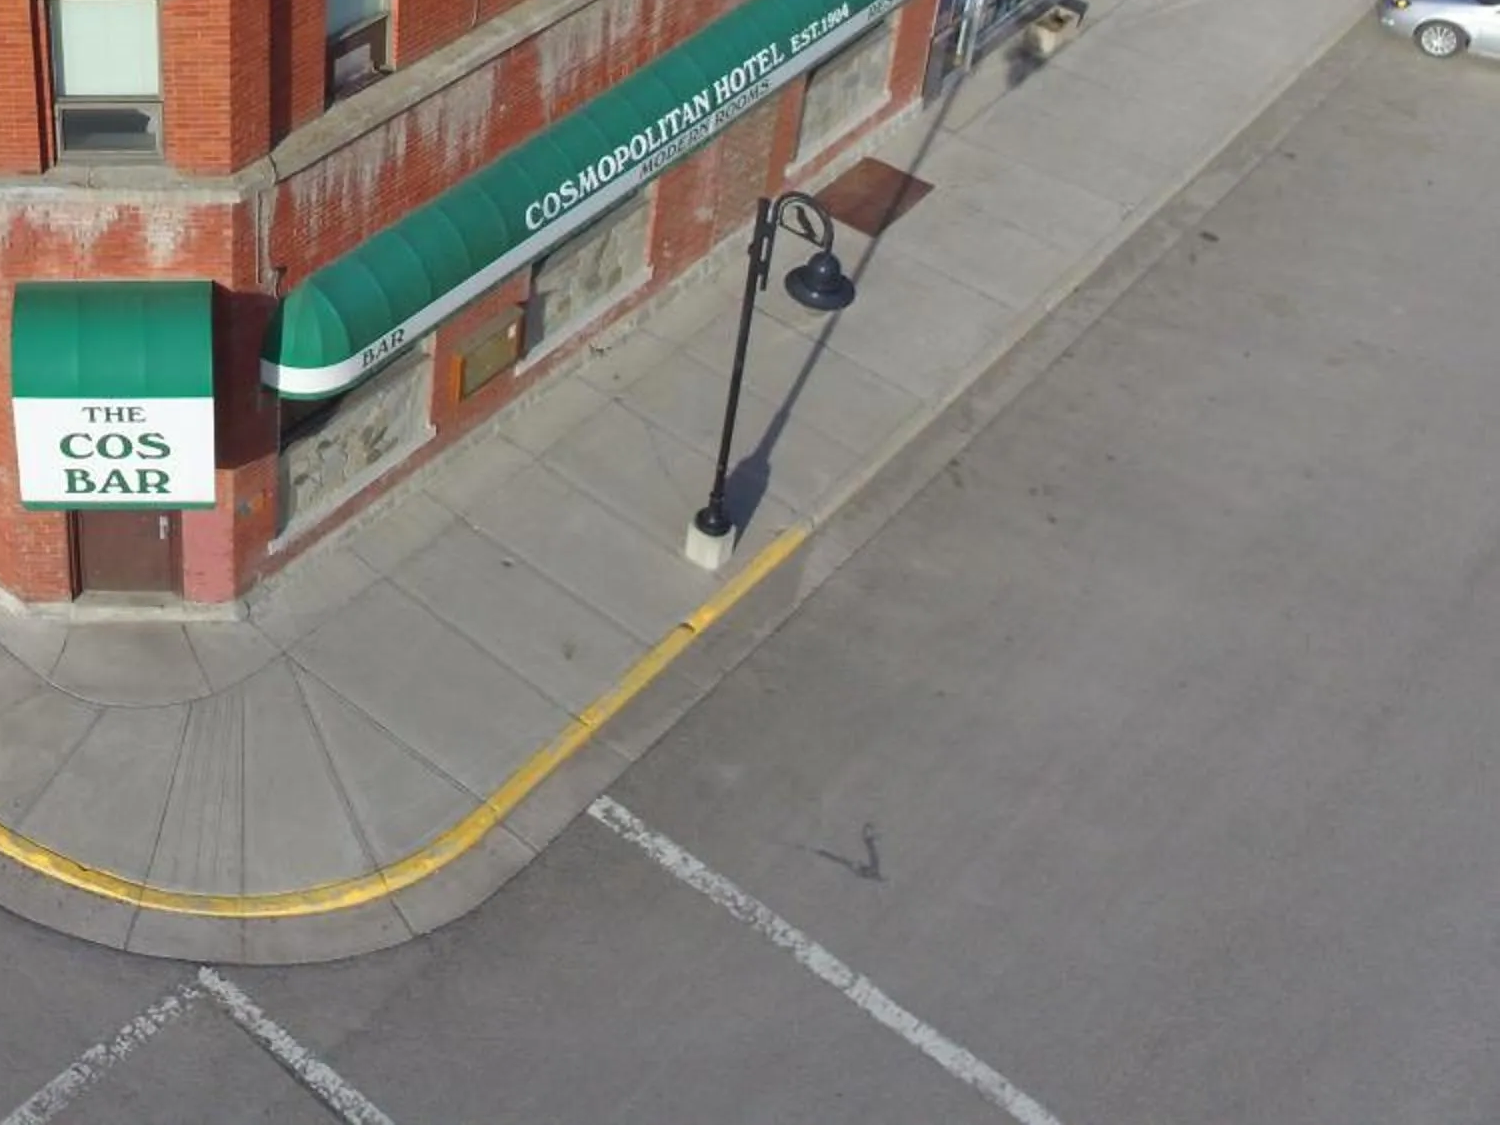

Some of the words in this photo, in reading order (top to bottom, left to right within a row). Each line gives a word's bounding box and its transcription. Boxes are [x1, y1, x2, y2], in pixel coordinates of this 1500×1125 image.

[525, 89, 710, 231] COSMOPOLITAN
[713, 42, 786, 105] HOTEL
[638, 116, 712, 181] MODERN
[713, 80, 771, 126] ROOMS
[360, 328, 406, 369] BAR
[81, 405, 147, 424] THE
[59, 432, 172, 460] COS
[64, 468, 172, 495] BAR
